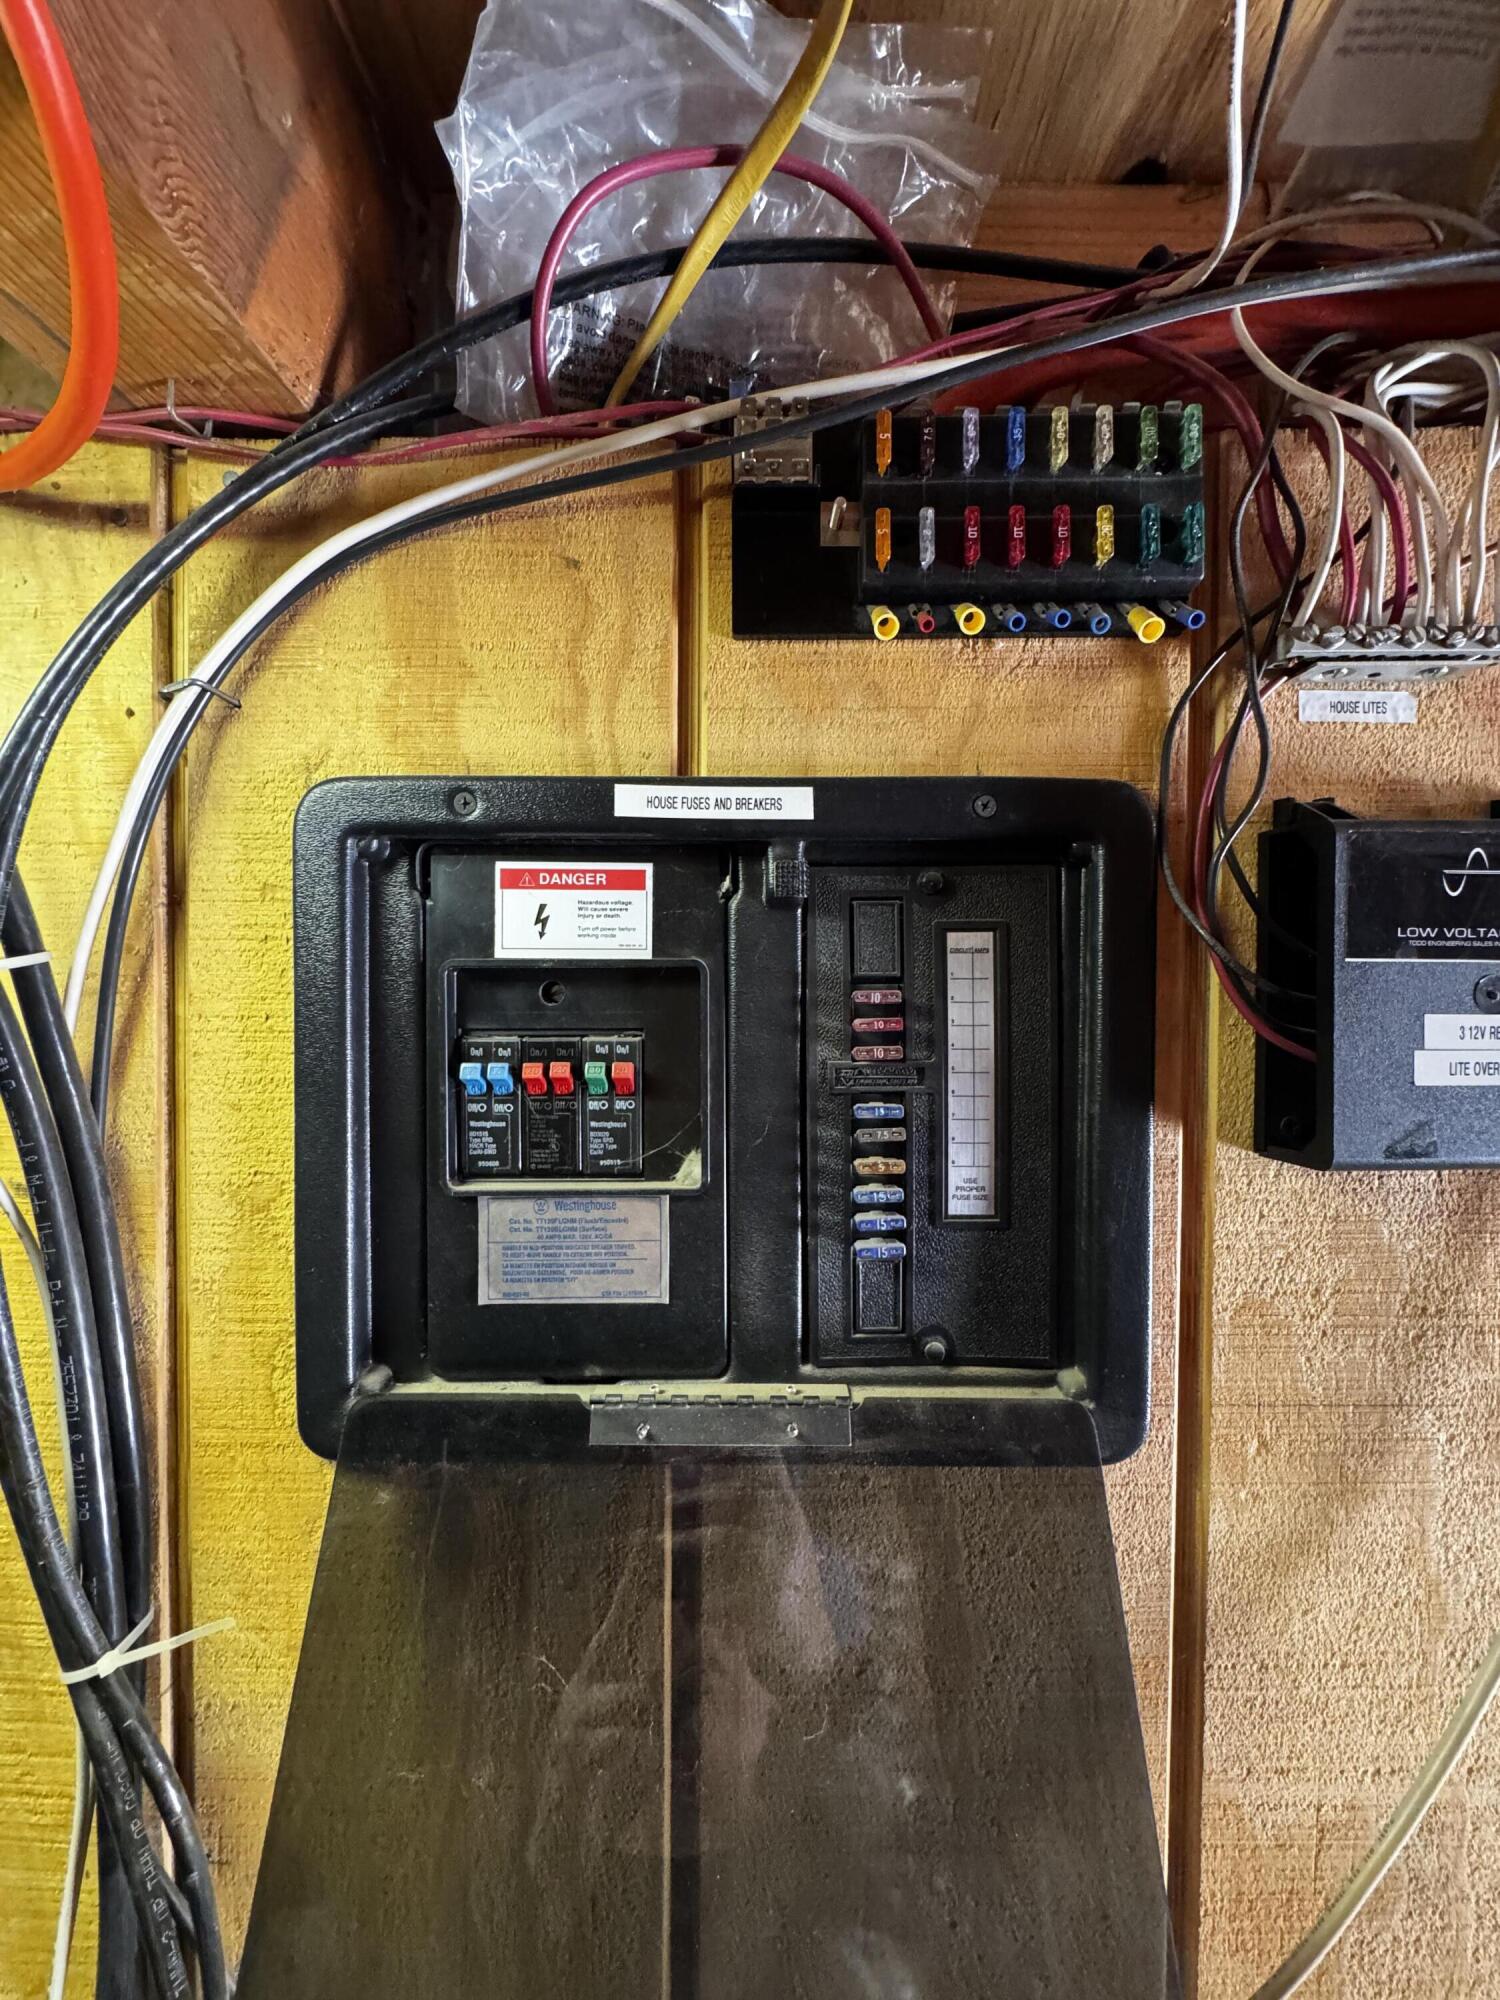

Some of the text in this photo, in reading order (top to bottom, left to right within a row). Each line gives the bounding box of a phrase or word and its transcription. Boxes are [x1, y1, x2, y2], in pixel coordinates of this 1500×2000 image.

[879, 432, 891, 440] 5
[967, 526, 978, 538] 10
[1013, 526, 1024, 538] 10
[1058, 526, 1069, 538] 10
[1329, 700, 1388, 714] HOUSE LITES
[646, 795, 783, 811] HOUSE FUSES AND BREAKERS
[539, 872, 607, 886] DANGER
[1397, 927, 1500, 938] LOW VOLTA
[871, 992, 881, 1004] 10
[874, 1021, 884, 1029] 10
[1459, 1025, 1465, 1040] 3
[1469, 1025, 1487, 1040] 12V
[873, 1048, 884, 1058] 10
[1449, 1061, 1470, 1076] LITE
[874, 1107, 884, 1116] 15
[469, 1120, 506, 1128] Westinghouse
[878, 1163, 885, 1172] 5
[963, 1177, 978, 1185] USE
[955, 1185, 986, 1193] PROPER
[873, 1192, 886, 1202] 15
[952, 1193, 971, 1201] FUSE
[554, 1200, 616, 1213] Westinghouse
[877, 1219, 887, 1230] 15
[877, 1247, 888, 1258] 15
